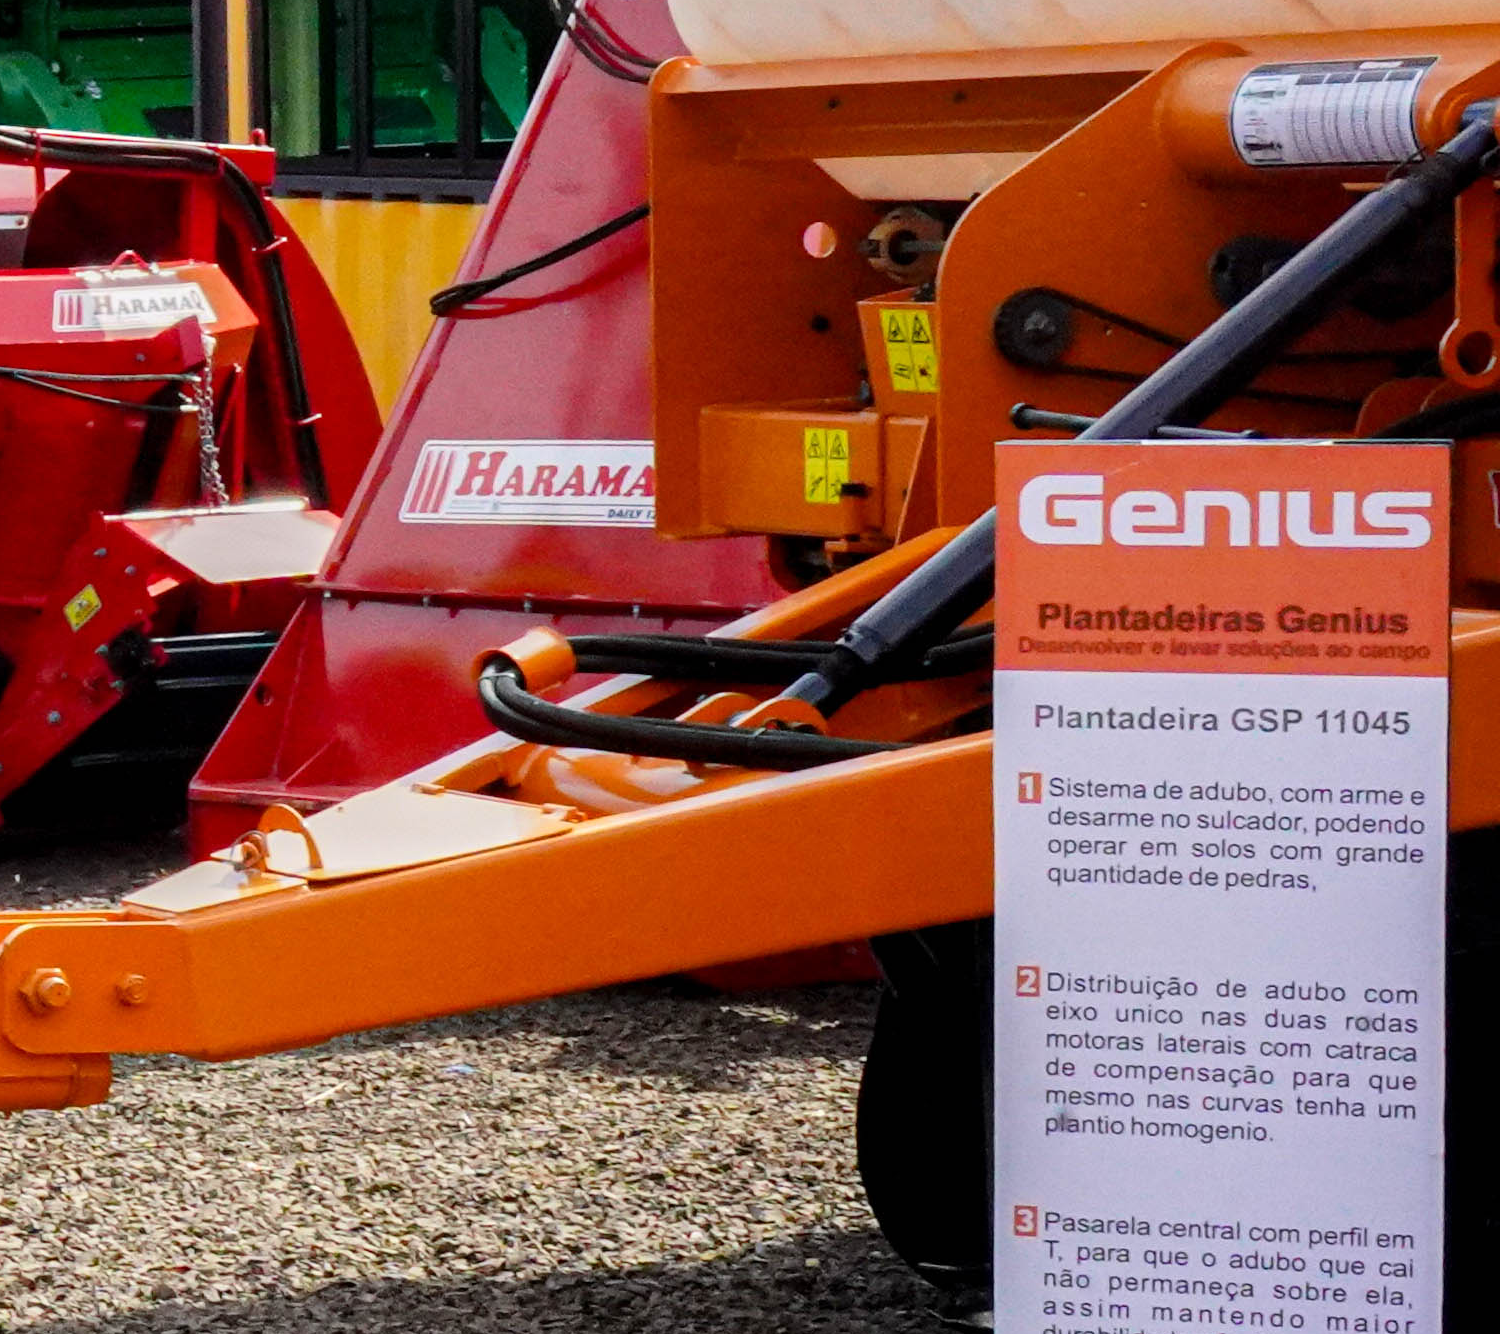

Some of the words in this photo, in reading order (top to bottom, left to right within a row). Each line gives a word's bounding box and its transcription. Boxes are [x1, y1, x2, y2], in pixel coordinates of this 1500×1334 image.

[1018, 474, 1432, 549] Genius
[1038, 602, 1265, 633] Plantadeiras
[1276, 604, 1409, 636] Genius
[1034, 704, 1219, 732] Plantadeira
[1231, 707, 1303, 733] GSP
[1315, 709, 1411, 736] 11045
[1048, 776, 1147, 799] Sistema
[1153, 779, 1184, 800] de
[1189, 781, 1273, 804] adubo,
[1280, 787, 1334, 804] com
[1339, 788, 1404, 806] arme
[1410, 790, 1426, 806] e
[1047, 806, 1155, 828] desarme
[1161, 813, 1191, 829] no
[1196, 810, 1308, 834] sulcador,
[1315, 813, 1426, 837] podendo
[1047, 838, 1128, 859] operar
[1140, 840, 1178, 857] em
[1191, 838, 1256, 859] solos
[1269, 844, 1322, 861] com
[1335, 843, 1425, 867] grande
[1046, 865, 1184, 888] quantidade
[1188, 866, 1219, 887] de
[1047, 971, 1199, 1001] Distribuição
[1215, 978, 1247, 999] de
[1264, 980, 1347, 1003] adubo
[1363, 987, 1418, 1004] com
[1045, 1004, 1098, 1022] eixo
[1115, 1003, 1184, 1025] unico
[1201, 1010, 1247, 1027] nas
[1264, 1008, 1327, 1031] duas
[1345, 1012, 1418, 1034] rodas
[1046, 1031, 1144, 1052] motoras
[1157, 1032, 1247, 1056] laterais
[1259, 1041, 1312, 1058] com
[1325, 1041, 1417, 1063] catraca
[1045, 1056, 1076, 1077] de
[1093, 1063, 1275, 1088] compensação
[1292, 1071, 1350, 1091] para
[1368, 1074, 1417, 1095] que
[1045, 1089, 1135, 1108] mesmo
[1146, 1093, 1191, 1110] nas
[1202, 1095, 1284, 1114] curvas
[1295, 1096, 1366, 1118] tenha
[1378, 1103, 1417, 1120] um
[1045, 1112, 1125, 1137] plantio
[1130, 1115, 1274, 1145] homogenio.
[1044, 1211, 1151, 1236] Pasarela
[1158, 1220, 1241, 1241] central
[1248, 1226, 1301, 1244] com
[1308, 1226, 1368, 1250] perfil
[1375, 1233, 1414, 1250] em
[1043, 1239, 1063, 1262] T,
[1076, 1246, 1130, 1265] para
[1143, 1249, 1189, 1269] que
[1201, 1252, 1217, 1268] o
[1228, 1250, 1307, 1273] adubo
[1318, 1258, 1366, 1279] que
[1378, 1261, 1414, 1278] cai
[1043, 1268, 1091, 1289] não
[1108, 1275, 1255, 1302] permaneça
[1272, 1281, 1348, 1303] sobre
[1365, 1285, 1413, 1310] ela,
[1042, 1300, 1130, 1319] assim
[1151, 1306, 1305, 1329] mantendo
[1326, 1315, 1415, 1334] maior
